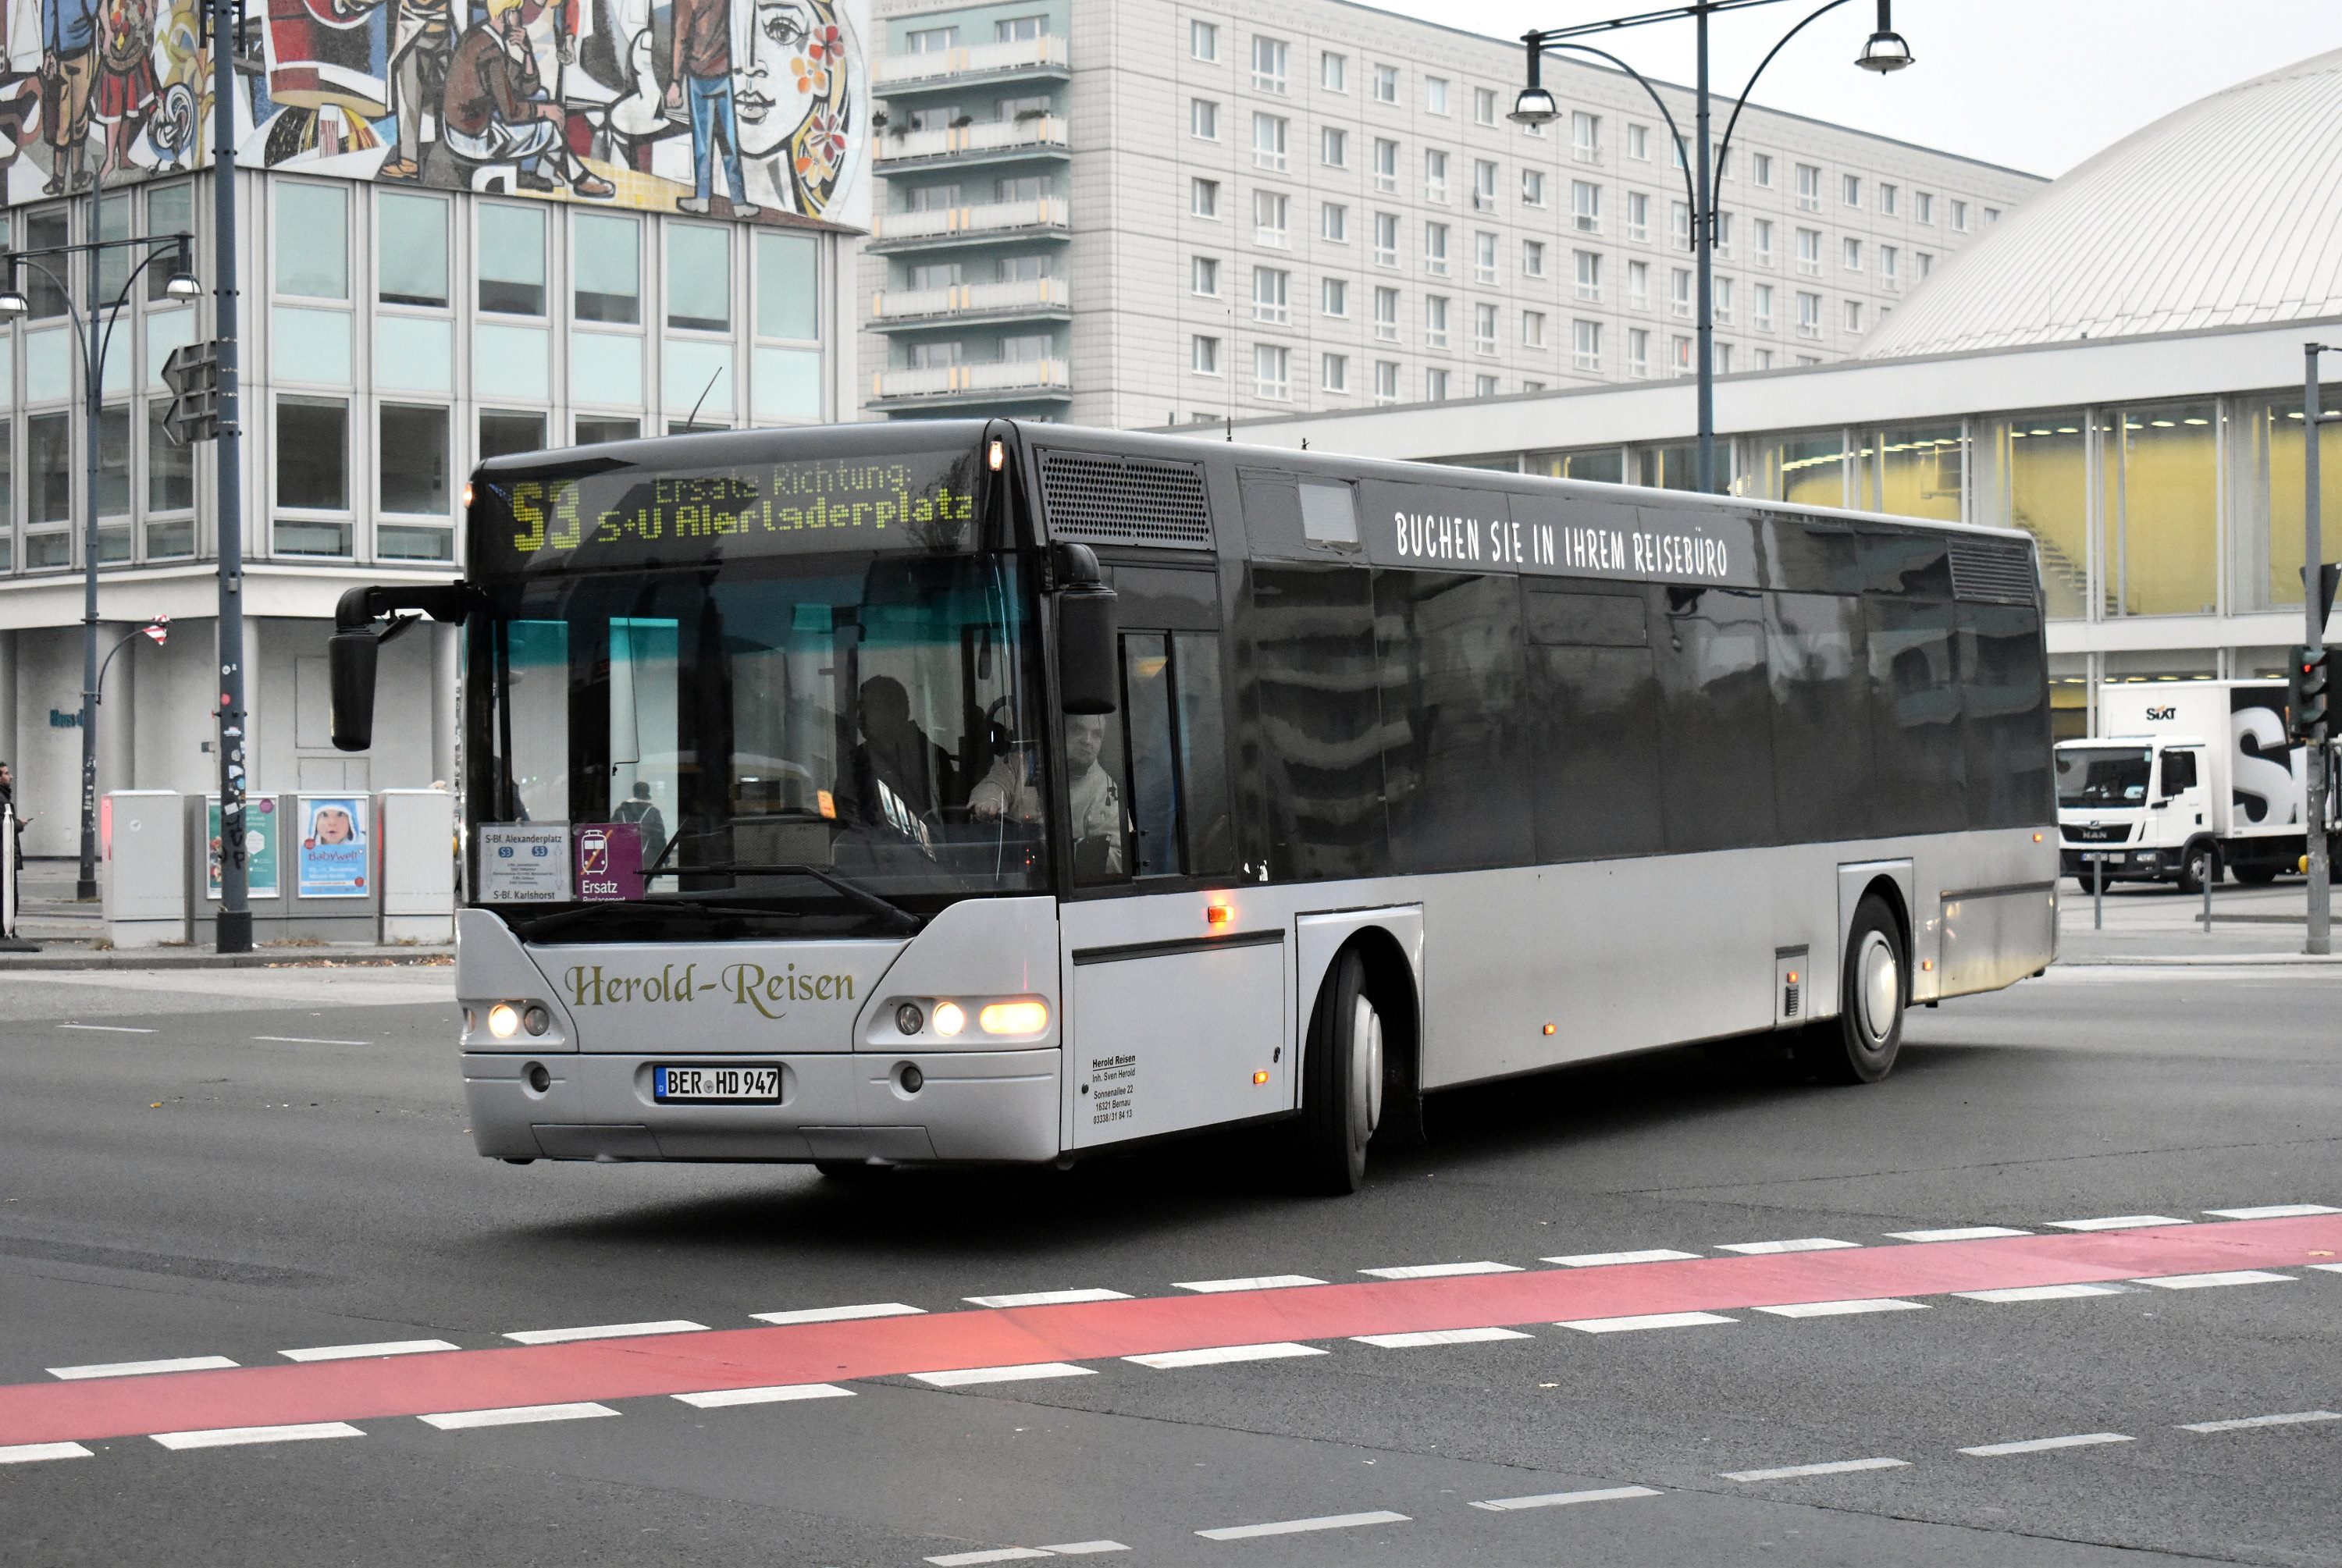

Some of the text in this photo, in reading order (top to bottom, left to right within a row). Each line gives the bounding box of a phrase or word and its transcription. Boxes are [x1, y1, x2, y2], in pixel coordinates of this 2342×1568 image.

[774, 460, 911, 496] Richtung:
[513, 480, 581, 552] S3
[598, 508, 662, 542] S+U
[1394, 511, 1727, 578] BUCHEN SIE IN IHREM REISEBÜRO
[506, 834, 561, 844] Alexanderplatz
[500, 847, 545, 857] S3 S3
[582, 880, 618, 894] Ersatz
[514, 891, 555, 899] Karlshorst
[564, 963, 855, 1019] Herold-Reisen
[1092, 1055, 1135, 1068] Herold Reisen
[1104, 1072, 1117, 1081] Sven
[1118, 1068, 1135, 1078] Herold
[668, 1072, 702, 1093] BER
[716, 1072, 739, 1093] HD
[744, 1072, 777, 1094] 947
[1094, 1085, 1134, 1099] Sonnenallee 22
[1095, 1099, 1130, 1111] 16321 Bernau
